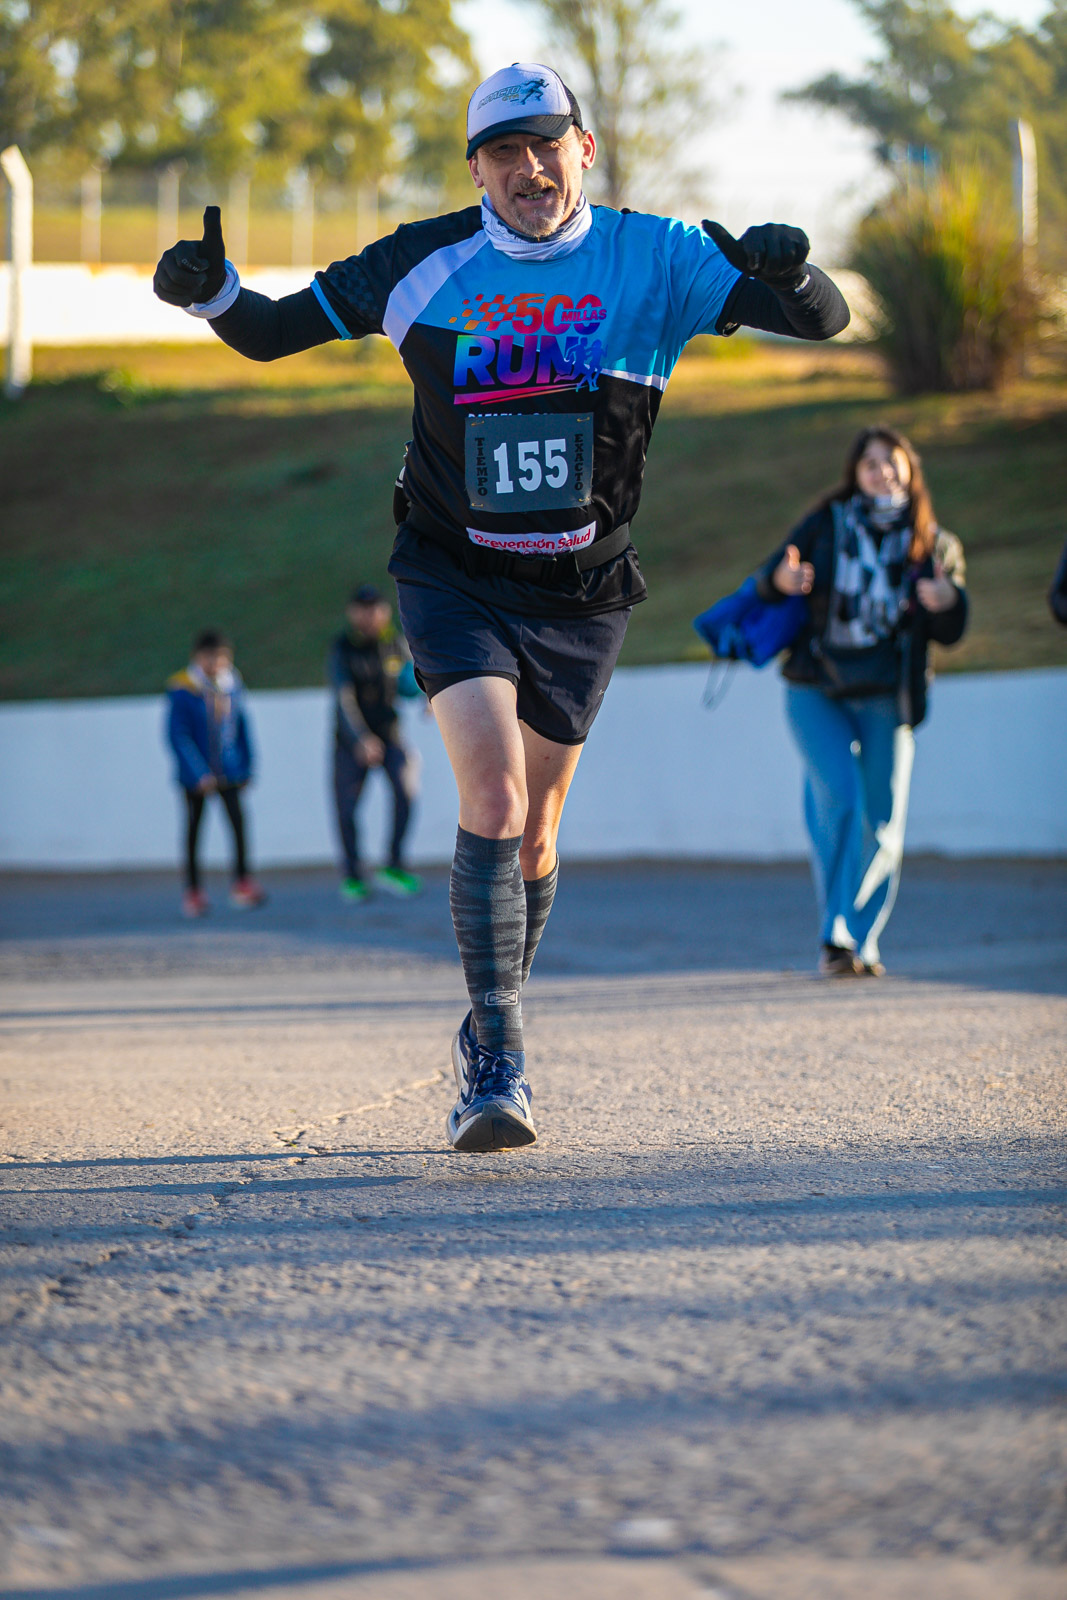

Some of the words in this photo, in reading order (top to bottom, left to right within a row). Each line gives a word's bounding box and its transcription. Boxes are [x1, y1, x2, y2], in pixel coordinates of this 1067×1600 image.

[511, 293, 602, 335] 500
[561, 309, 607, 322] MILLAS
[453, 335, 580, 386] RUN
[474, 437, 488, 497] TIEMPO
[493, 438, 569, 494] 155
[574, 433, 584, 491] EXACTO
[474, 534, 555, 549] Prevención
[557, 528, 591, 548] Salud
